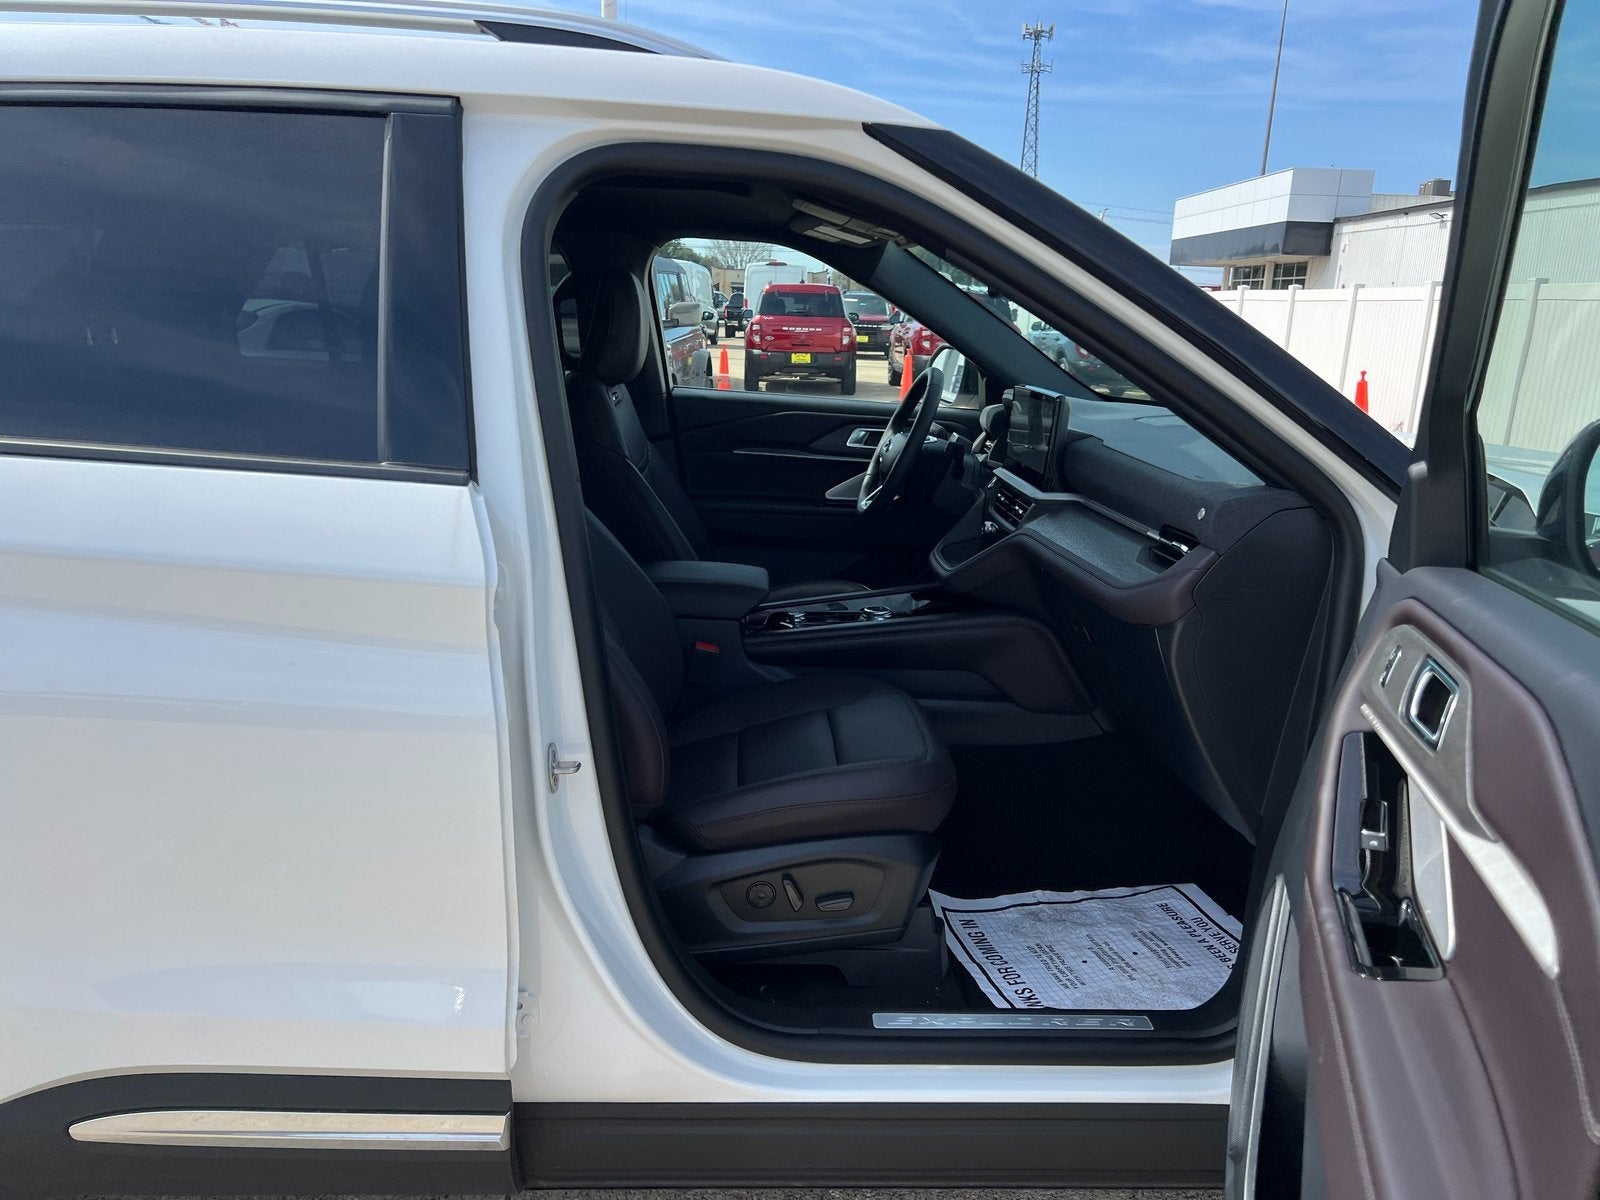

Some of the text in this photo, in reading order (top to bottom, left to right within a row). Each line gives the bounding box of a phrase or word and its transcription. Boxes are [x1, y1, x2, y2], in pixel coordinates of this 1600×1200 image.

[1156, 903, 1201, 937] PLEASURE
[1191, 917, 1238, 954] SERVE YOU
[959, 920, 1044, 1009] NKS FOR COMING IN
[1203, 945, 1232, 962] BEEN
[888, 1016, 1136, 1027] EXPLORER
